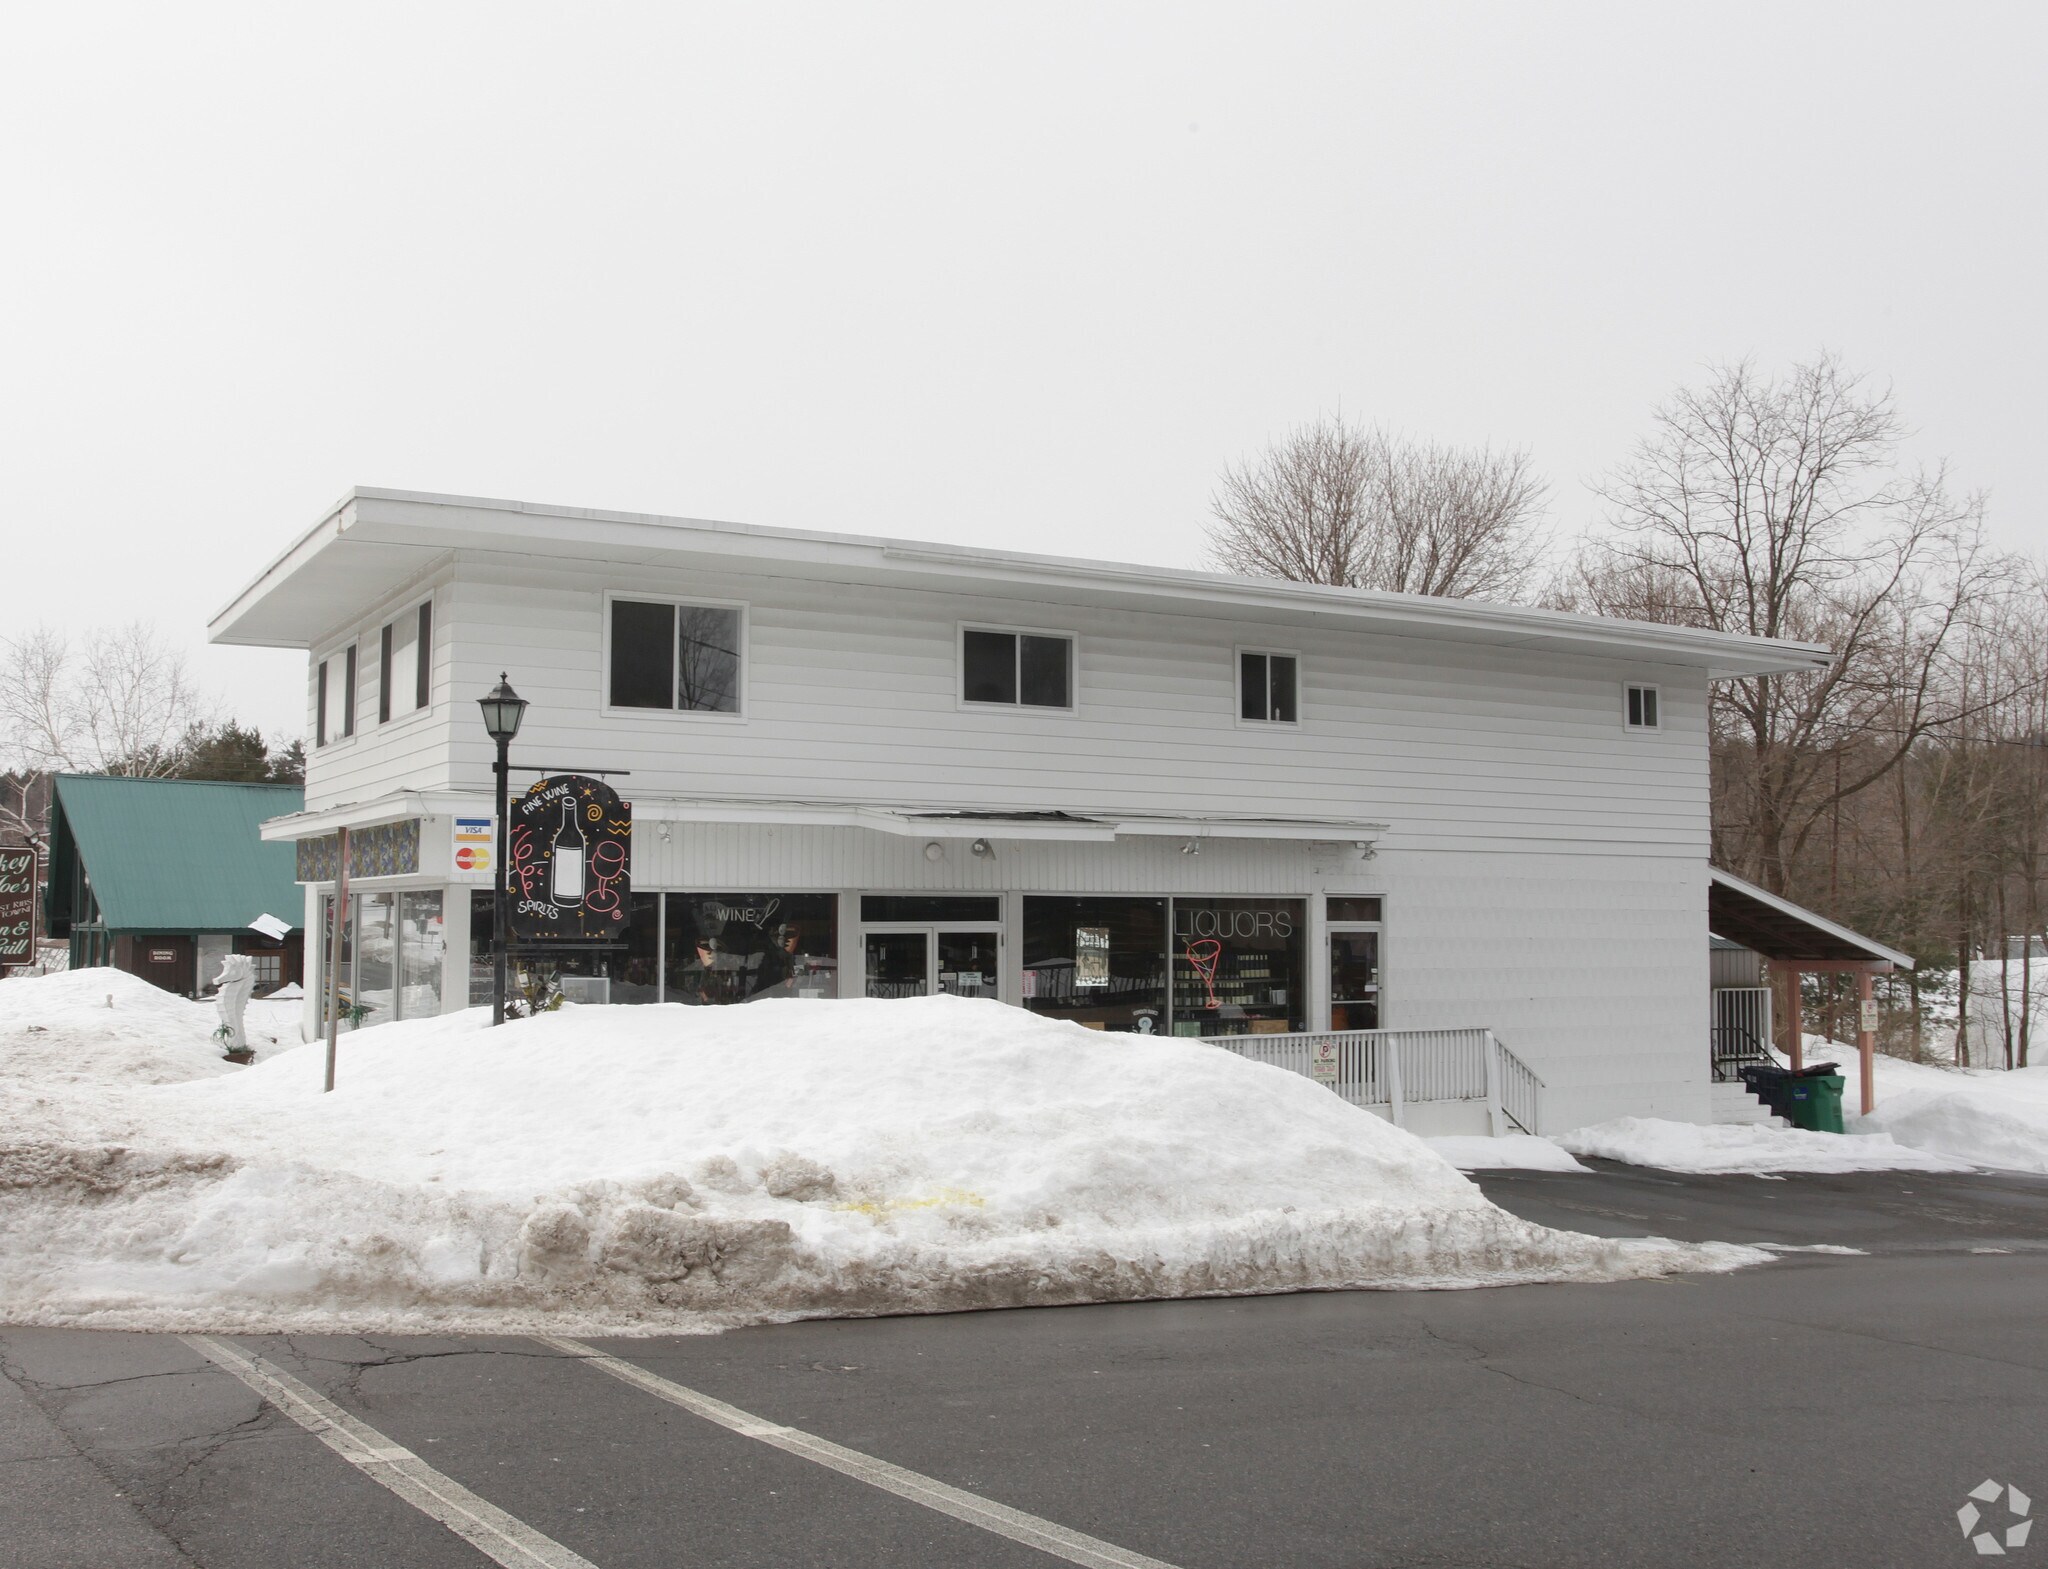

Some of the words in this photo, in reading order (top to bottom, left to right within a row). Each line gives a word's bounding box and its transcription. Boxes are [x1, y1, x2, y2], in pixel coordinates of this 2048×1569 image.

[521, 795, 543, 816] FINE
[542, 783, 570, 801] WINE
[517, 900, 560, 920] SPIRITS
[716, 908, 756, 922] WINE
[12, 920, 31, 936] &
[1173, 910, 1293, 938] LIQUORS
